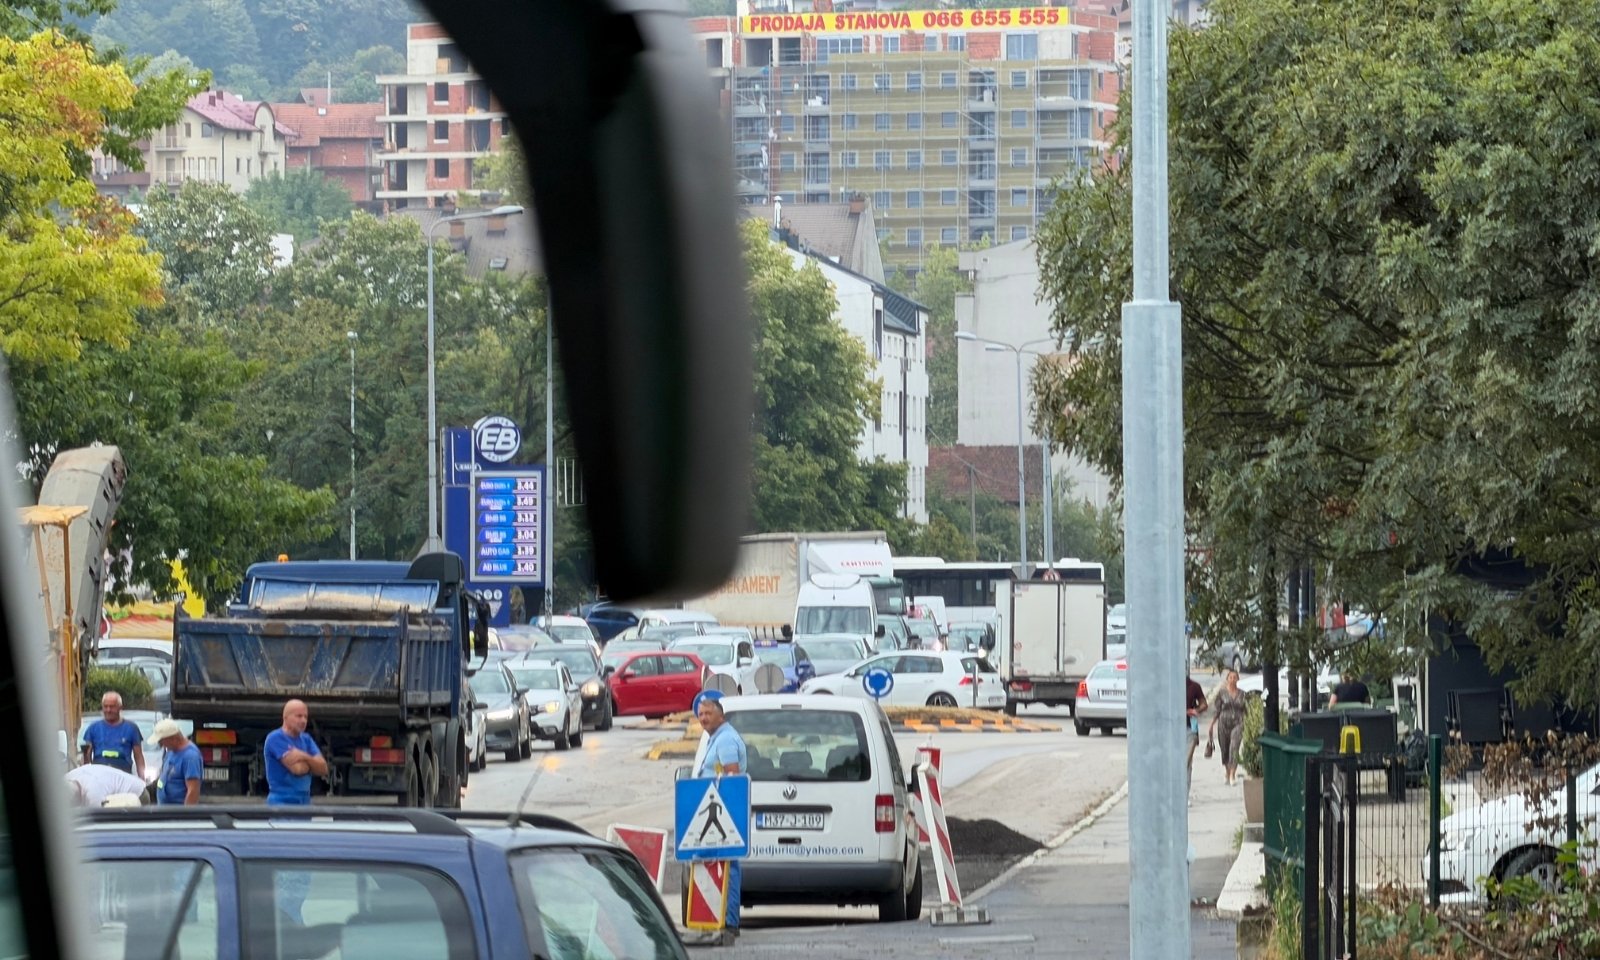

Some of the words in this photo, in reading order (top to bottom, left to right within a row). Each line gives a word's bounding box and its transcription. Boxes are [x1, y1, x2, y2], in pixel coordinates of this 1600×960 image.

[750, 14, 826, 32] PRODAJA
[835, 12, 911, 30] STANOVA
[923, 11, 964, 28] 066
[971, 9, 1011, 26] 655
[1019, 9, 1060, 25] 555
[480, 427, 517, 451] EB
